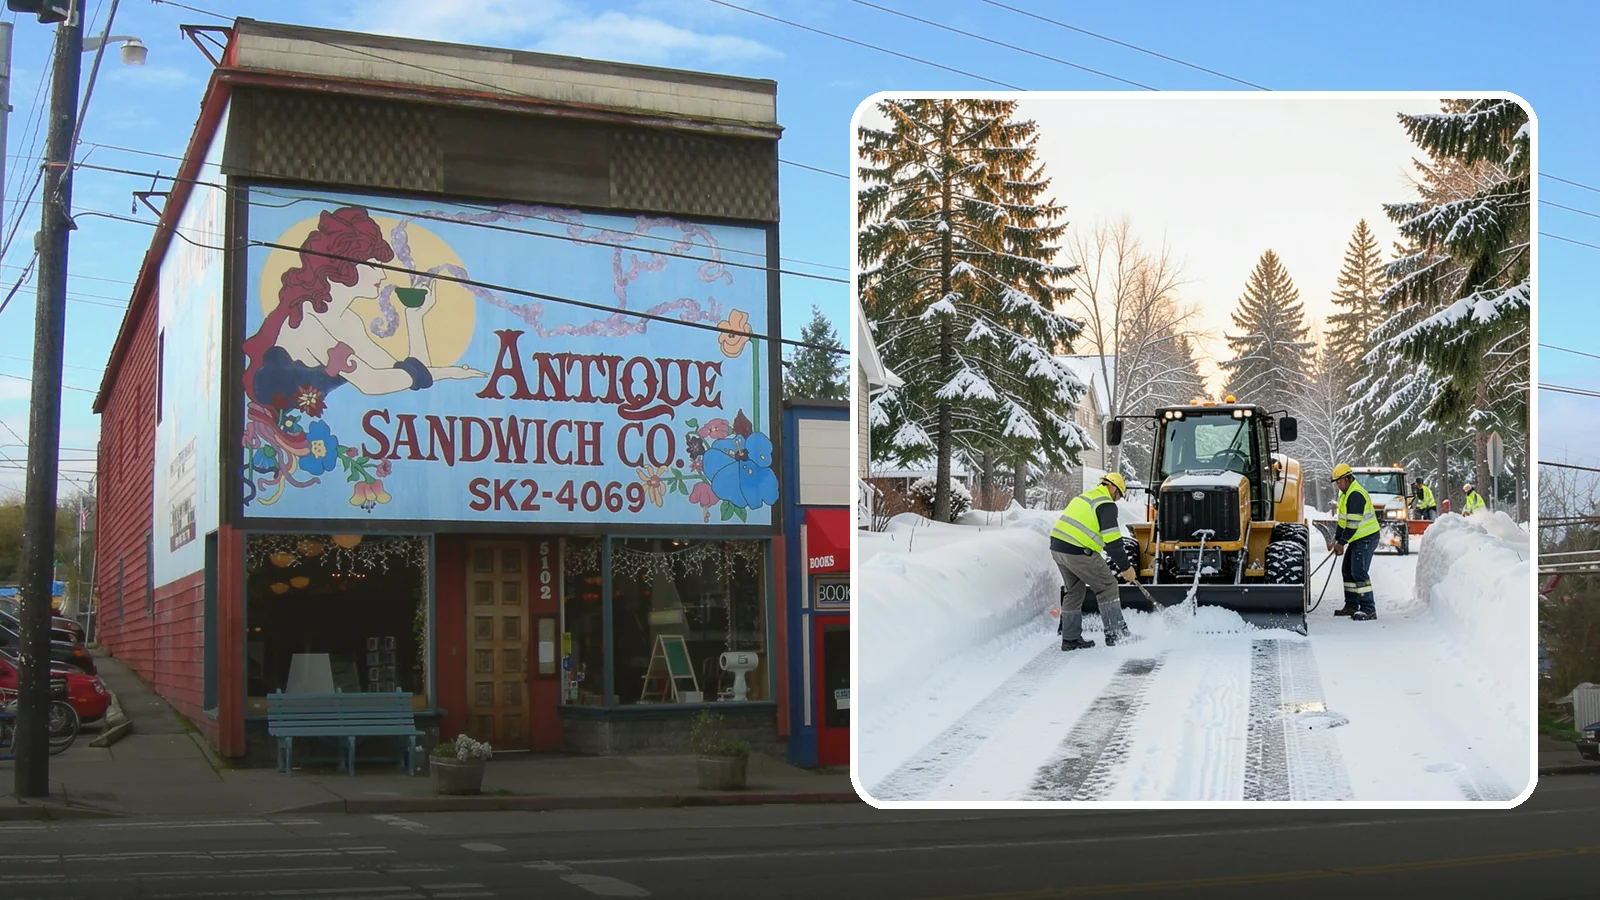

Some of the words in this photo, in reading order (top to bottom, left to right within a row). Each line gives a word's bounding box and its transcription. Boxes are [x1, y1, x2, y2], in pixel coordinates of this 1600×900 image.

[476, 329, 724, 421] ANTIQUE
[361, 408, 605, 467] SANDWICH
[616, 421, 686, 468] CO.
[467, 477, 646, 513] SK2-4069
[540, 541, 551, 599] 5102
[809, 555, 835, 569] BOOKS
